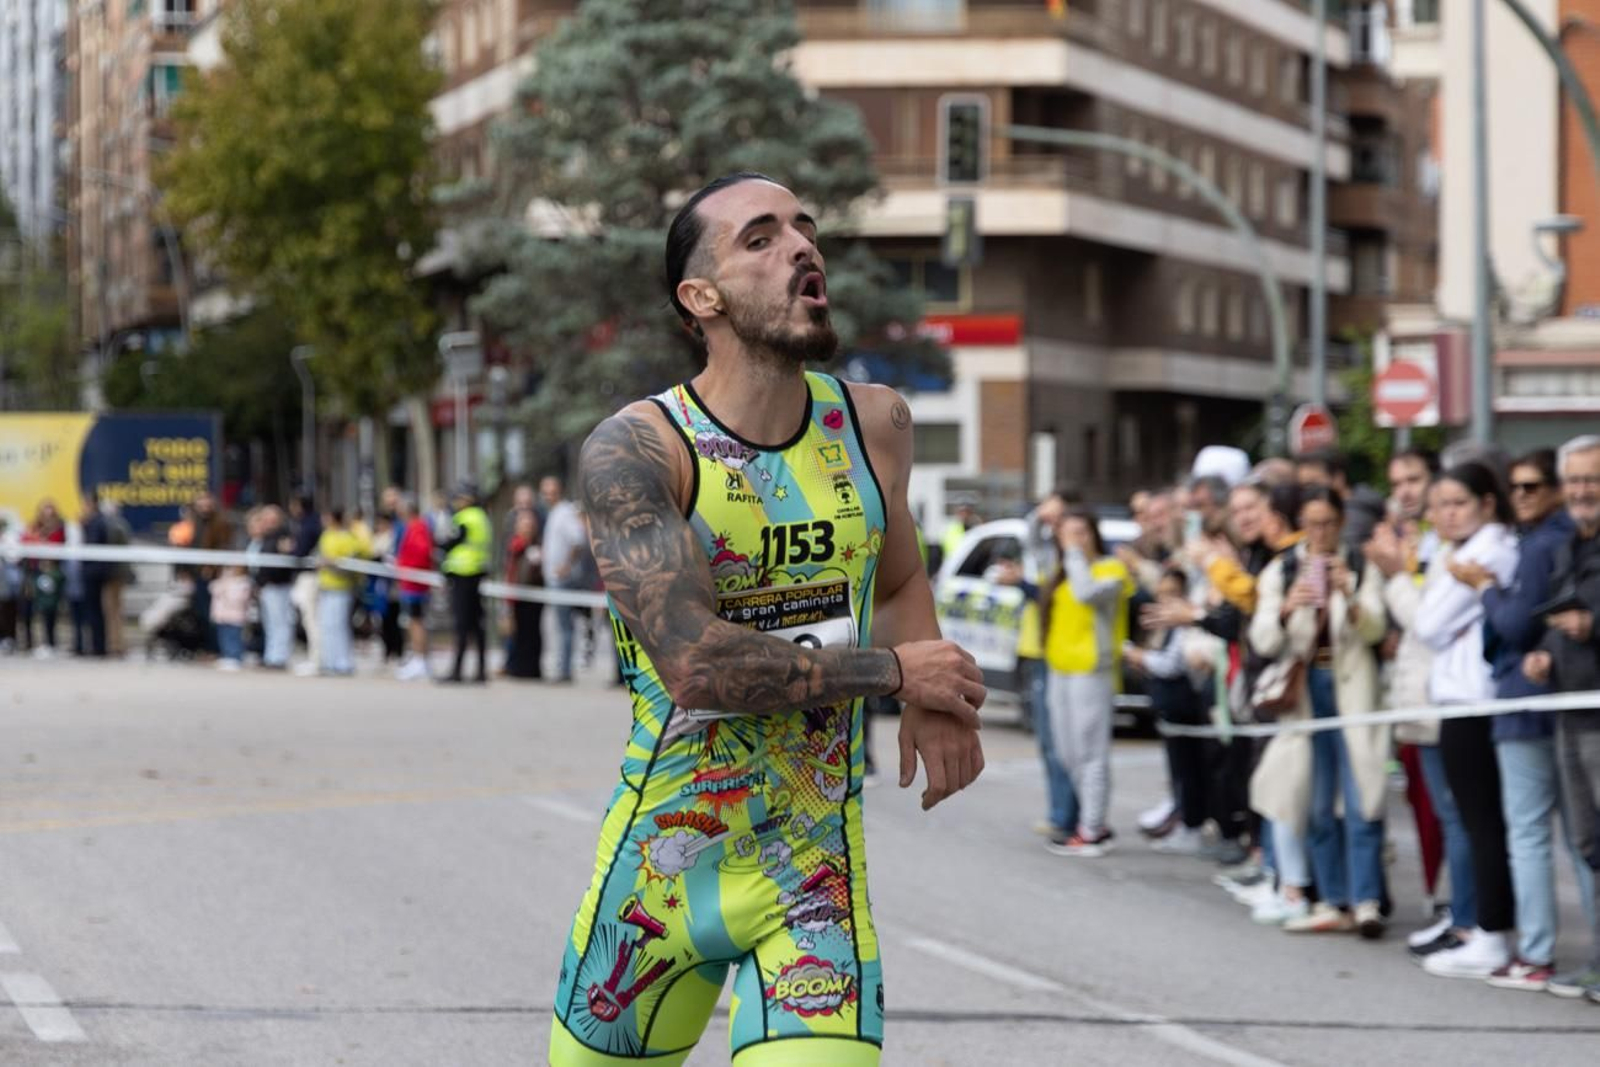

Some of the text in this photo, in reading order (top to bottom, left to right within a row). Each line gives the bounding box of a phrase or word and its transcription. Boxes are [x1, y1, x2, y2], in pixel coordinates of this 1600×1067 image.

[145, 437, 209, 459] TODO
[727, 492, 763, 504] RAFITA
[761, 520, 835, 567] 1153
[714, 570, 763, 592] OOM!
[725, 593, 783, 609] CARRERA
[785, 584, 843, 600] POPULAR
[725, 609, 734, 621] y
[742, 604, 777, 620] gran
[783, 593, 844, 611] caminata
[774, 974, 852, 1001] BOOM!
